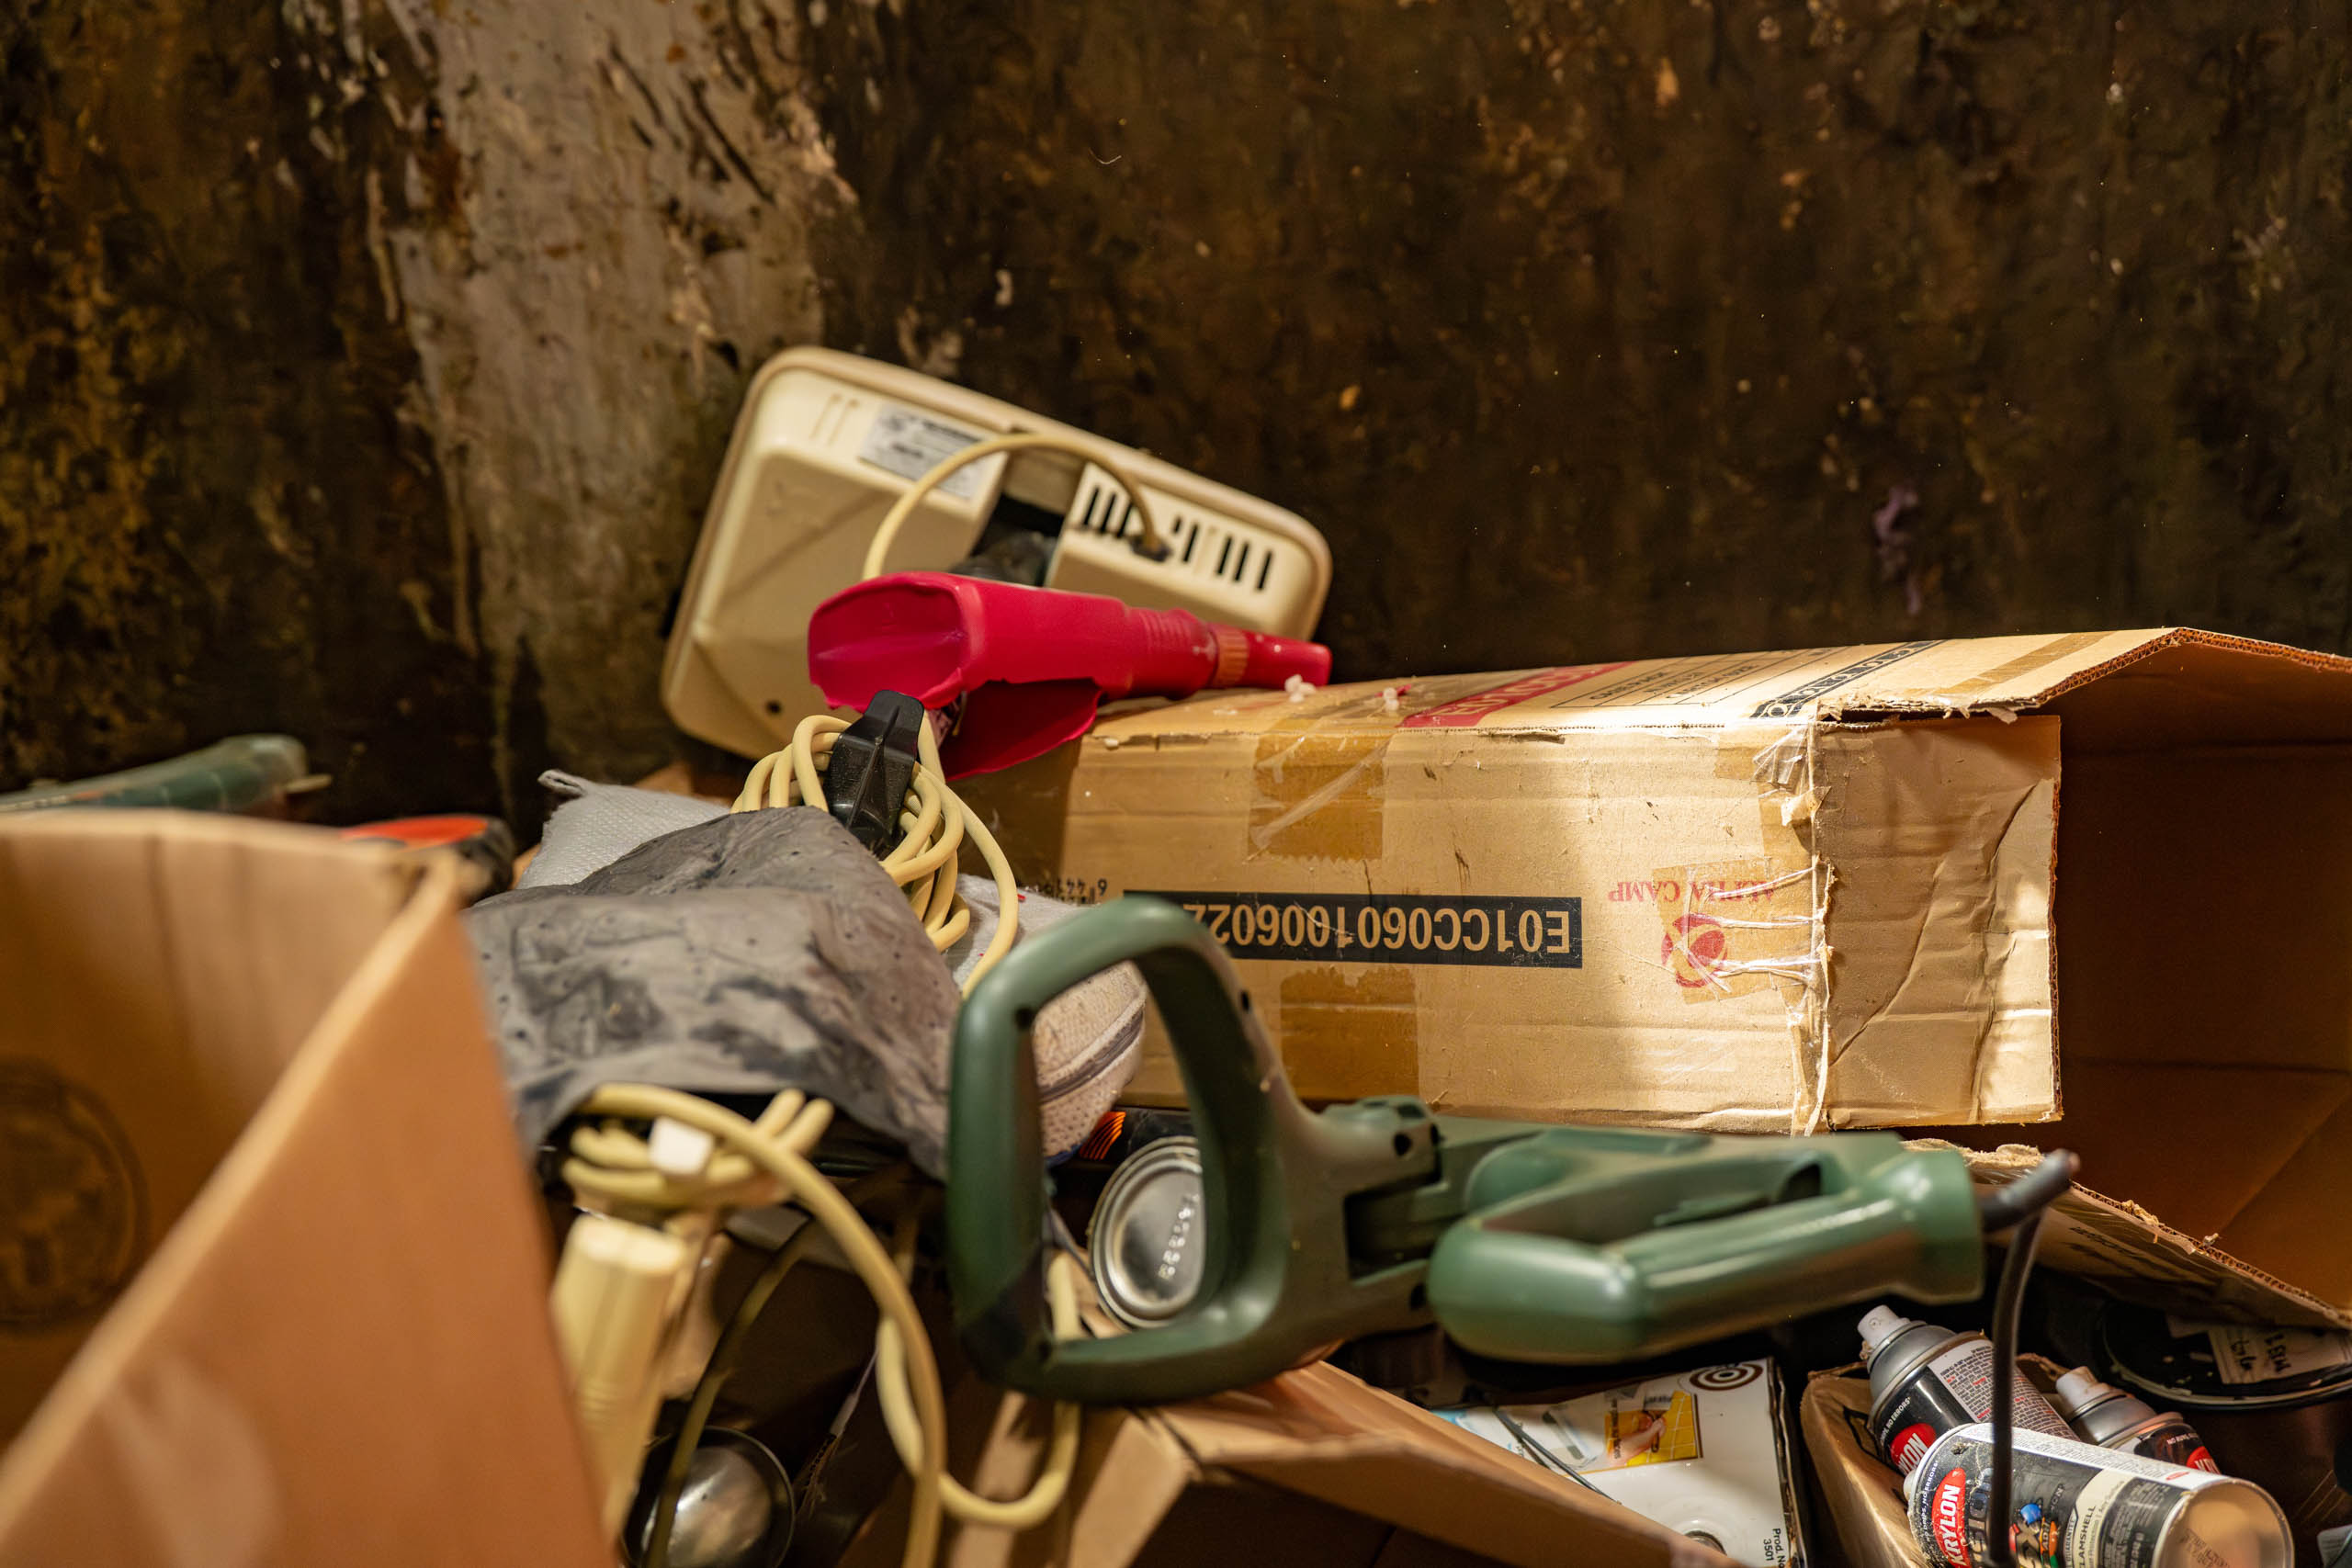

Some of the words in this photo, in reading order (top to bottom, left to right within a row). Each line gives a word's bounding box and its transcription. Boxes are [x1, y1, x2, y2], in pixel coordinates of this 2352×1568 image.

[1608, 880, 1680, 903] CAMP
[1939, 1483, 1968, 1566] KRYLON
[1763, 1539, 1774, 1562] 3501
[1772, 1528, 1784, 1554] Prod.
